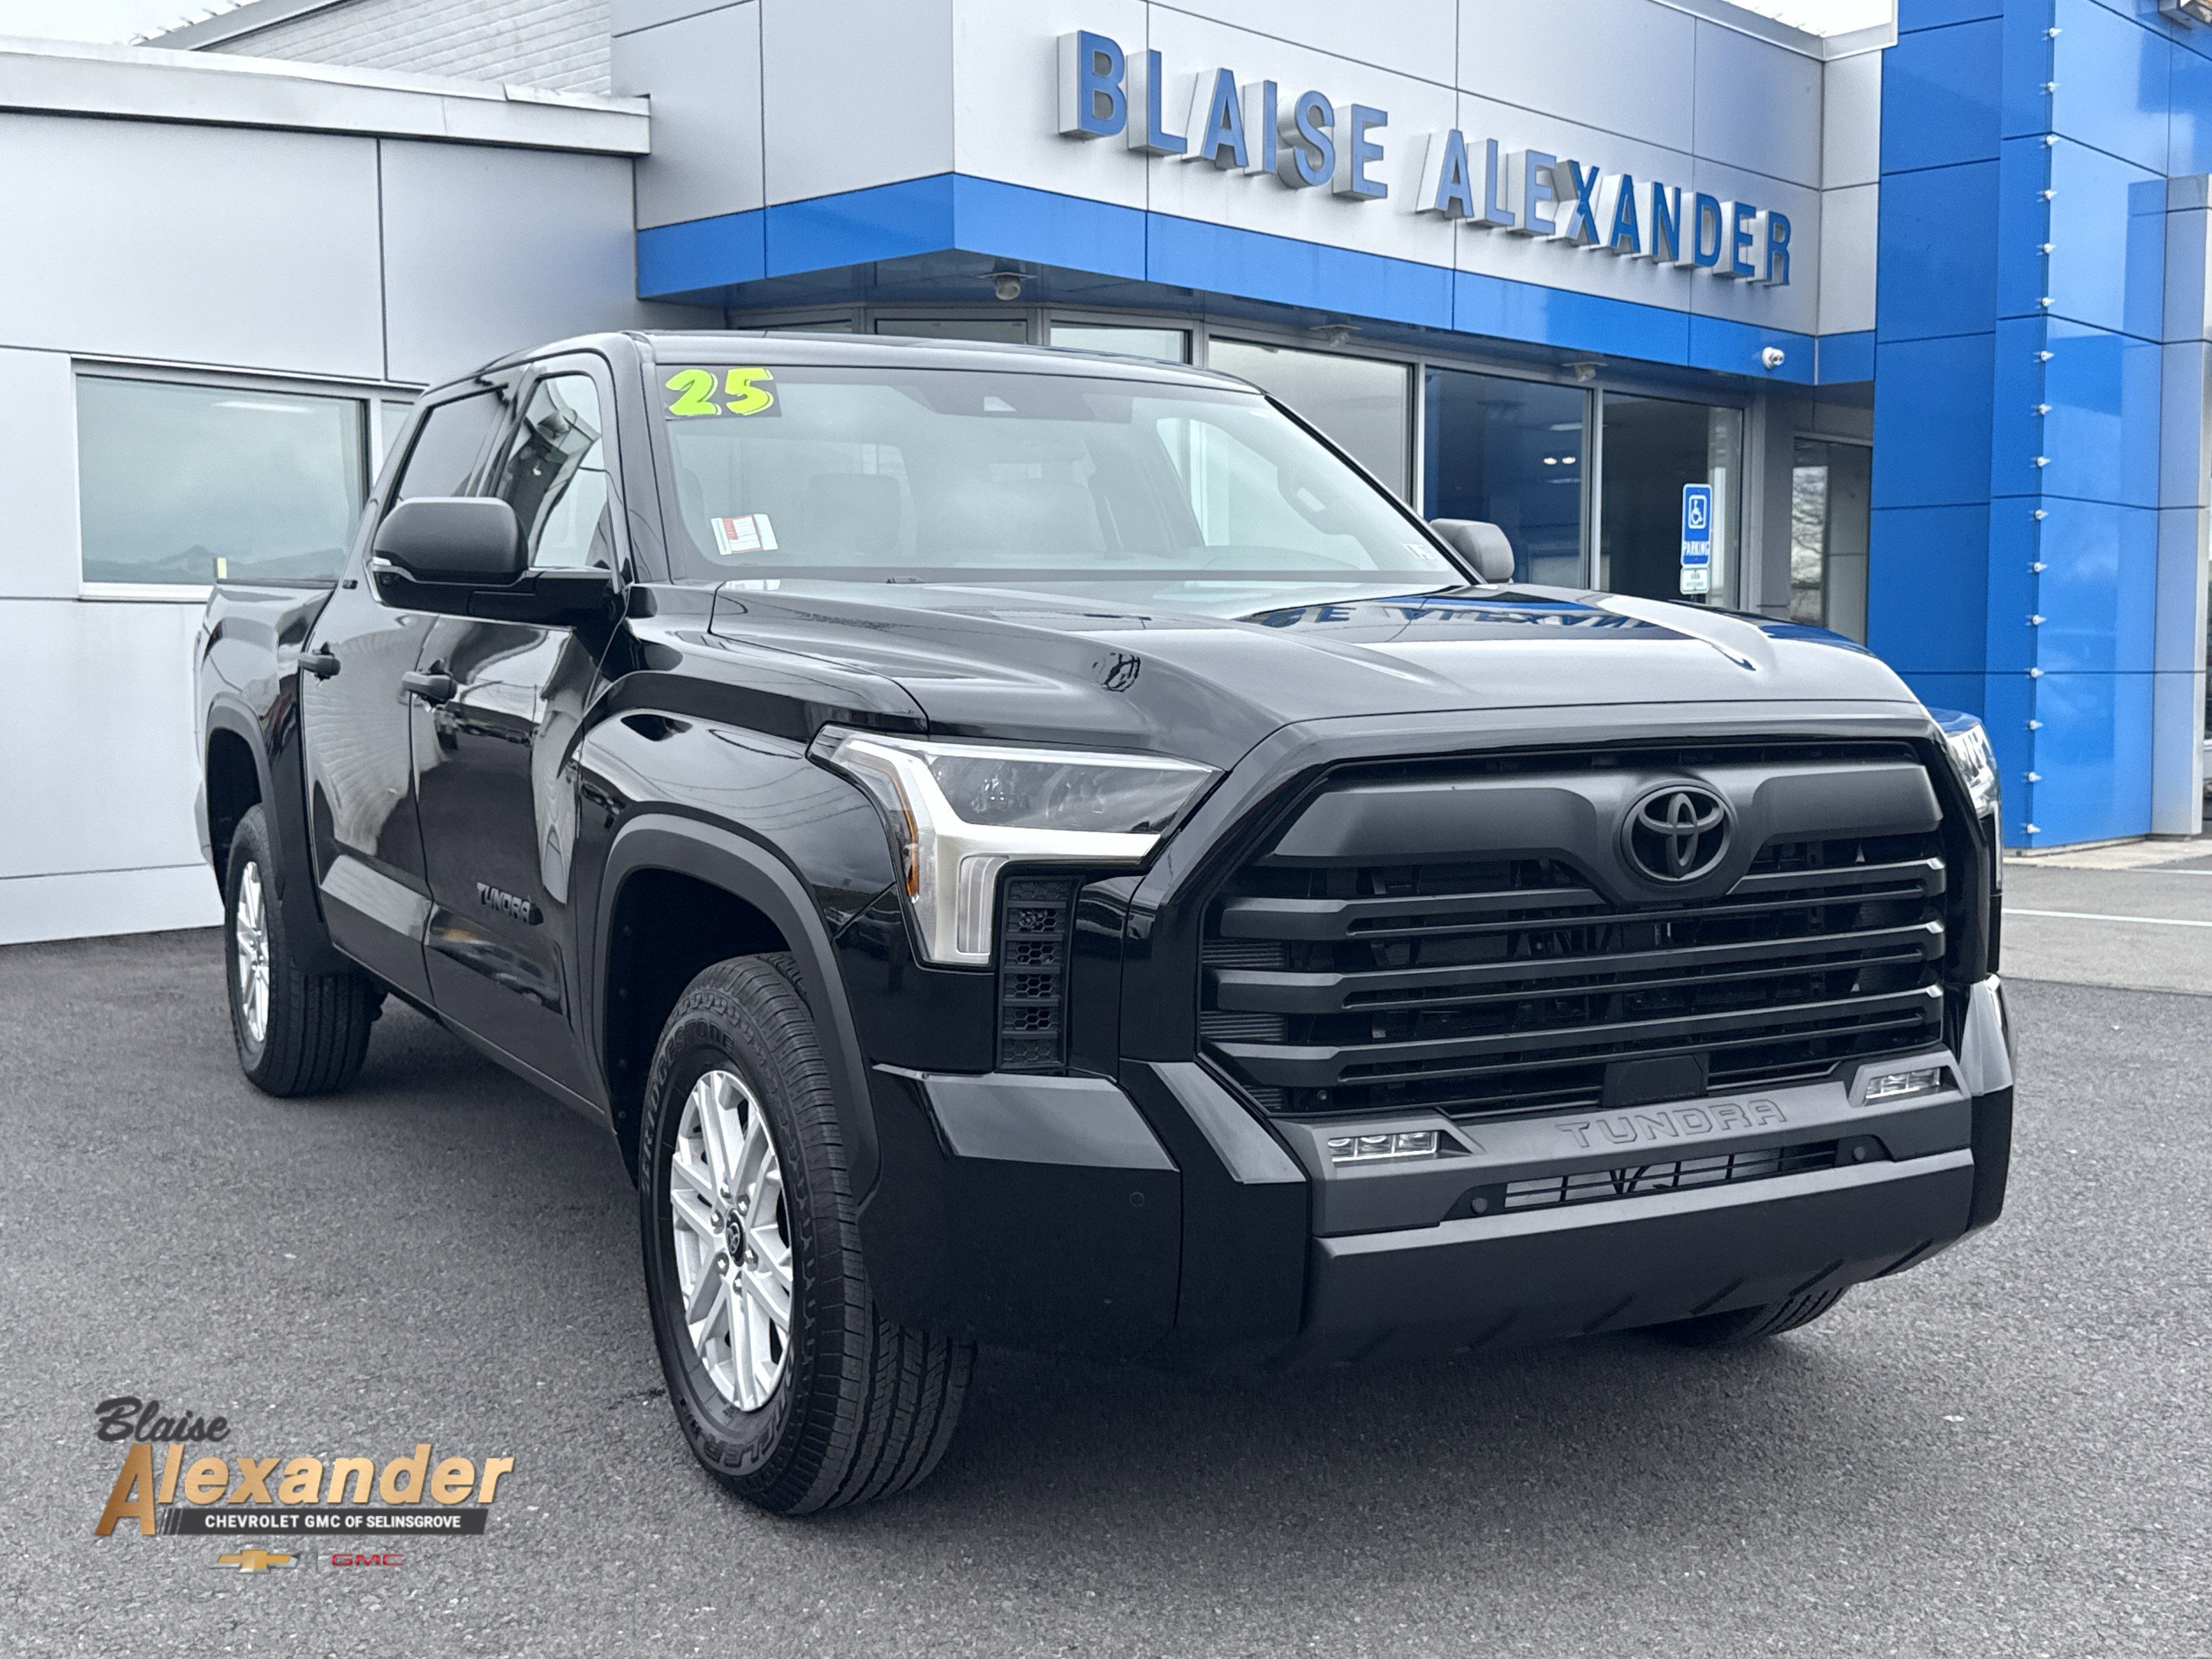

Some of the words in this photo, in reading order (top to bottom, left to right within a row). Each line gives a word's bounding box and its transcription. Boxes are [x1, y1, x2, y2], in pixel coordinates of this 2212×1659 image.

[1060, 30, 1388, 200] BLAISE
[1421, 128, 1791, 286] ALEXANDER
[665, 367, 774, 416] 25
[1683, 541, 1709, 556] PARKING
[477, 882, 531, 925] TUNDRA
[1555, 1098, 1788, 1148] TUNDRA
